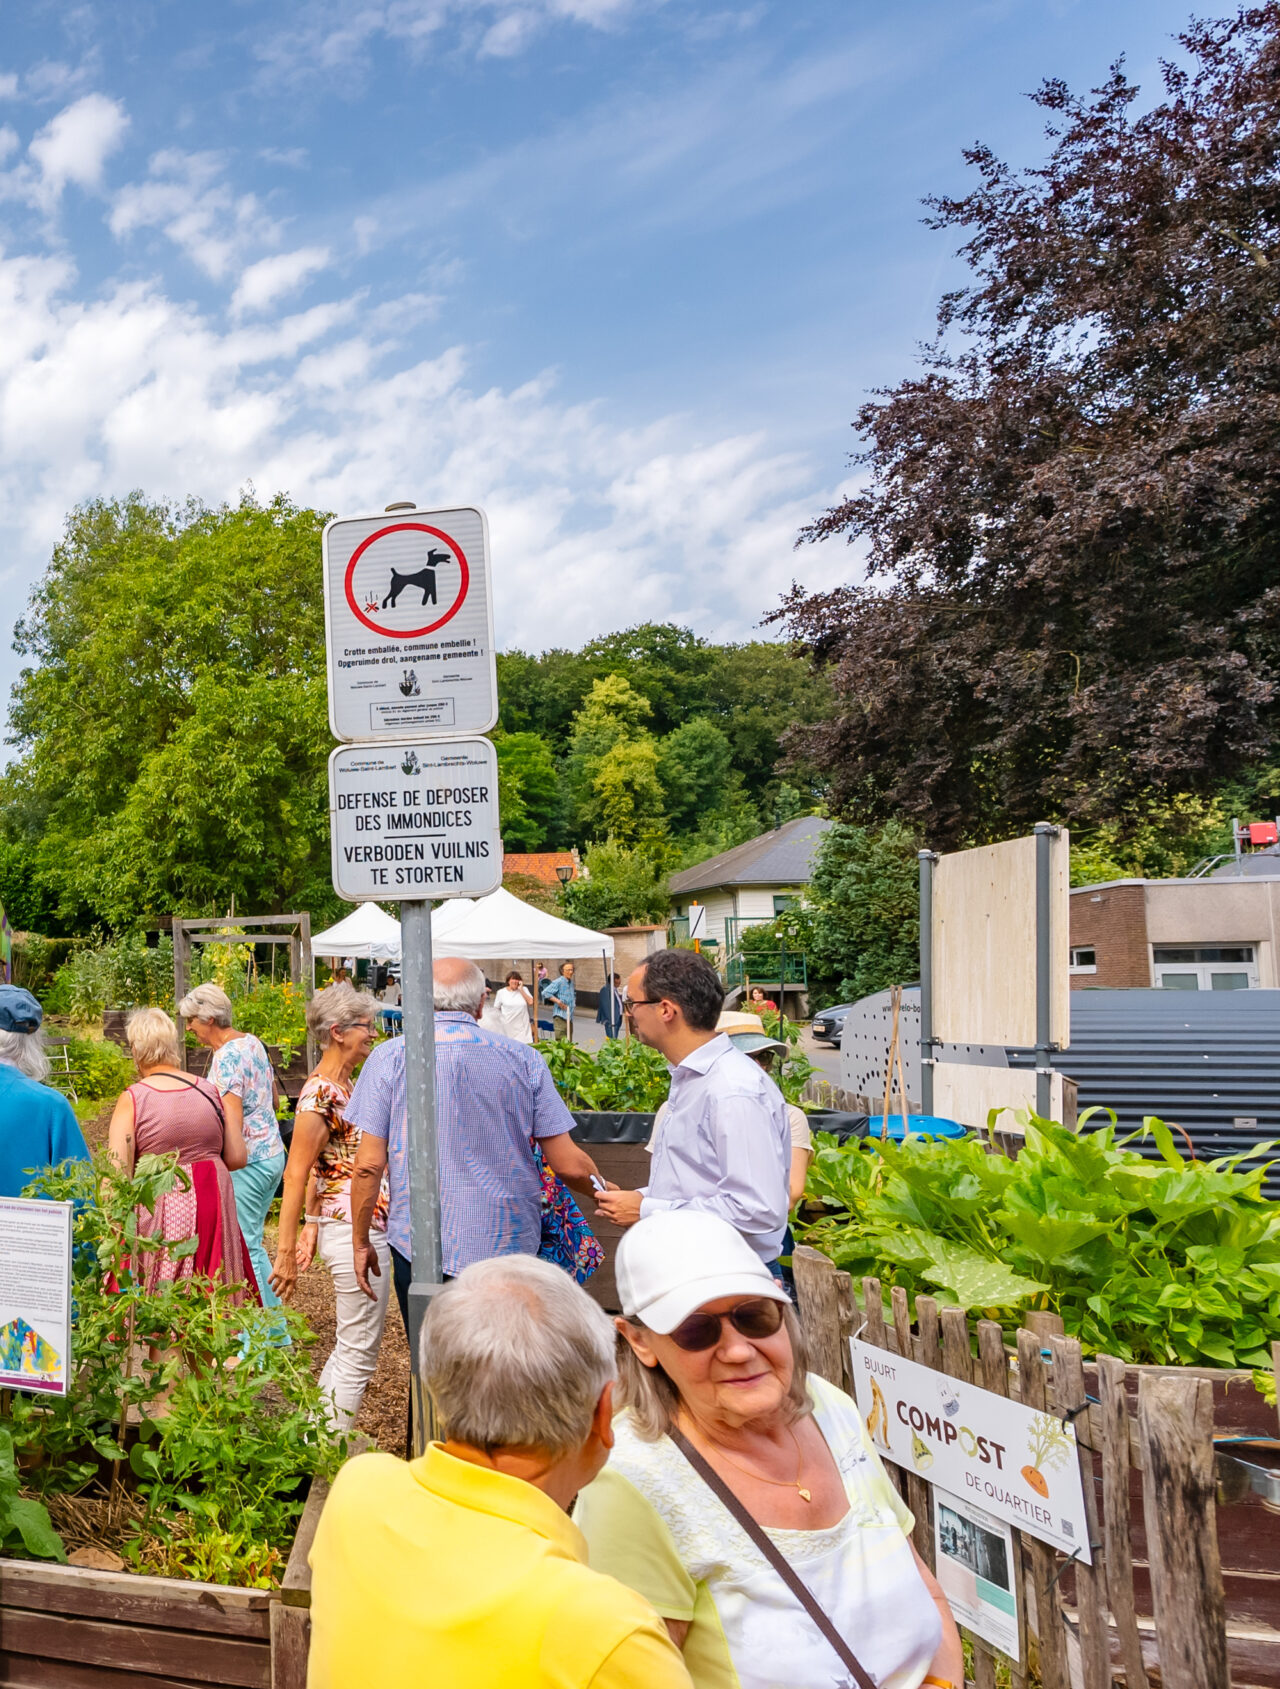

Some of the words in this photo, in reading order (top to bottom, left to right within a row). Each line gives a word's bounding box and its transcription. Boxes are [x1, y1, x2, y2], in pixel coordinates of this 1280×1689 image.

[337, 656, 380, 669] Opgeruimde
[381, 655, 399, 665] drol,
[399, 653, 441, 664] aangename
[442, 650, 479, 661] gemeente
[343, 648, 366, 657] Crotte
[367, 644, 402, 655] emballée,
[403, 642, 439, 652] commune
[440, 639, 471, 649] embellie
[337, 791, 398, 810] DEFENSE
[403, 790, 421, 807] DE
[426, 786, 489, 806] DEPOSER
[355, 814, 382, 832] DES
[387, 810, 473, 831] IMMONDICES
[343, 843, 425, 863] VERBODEN
[431, 840, 490, 860] VUILNIS
[370, 868, 389, 885] TE
[395, 865, 464, 884] STORTEN
[863, 1356, 897, 1382] BUURT
[896, 1400, 1006, 1470] COMPOST
[965, 1471, 982, 1492] DE
[984, 1482, 1053, 1528] QUARTIER
